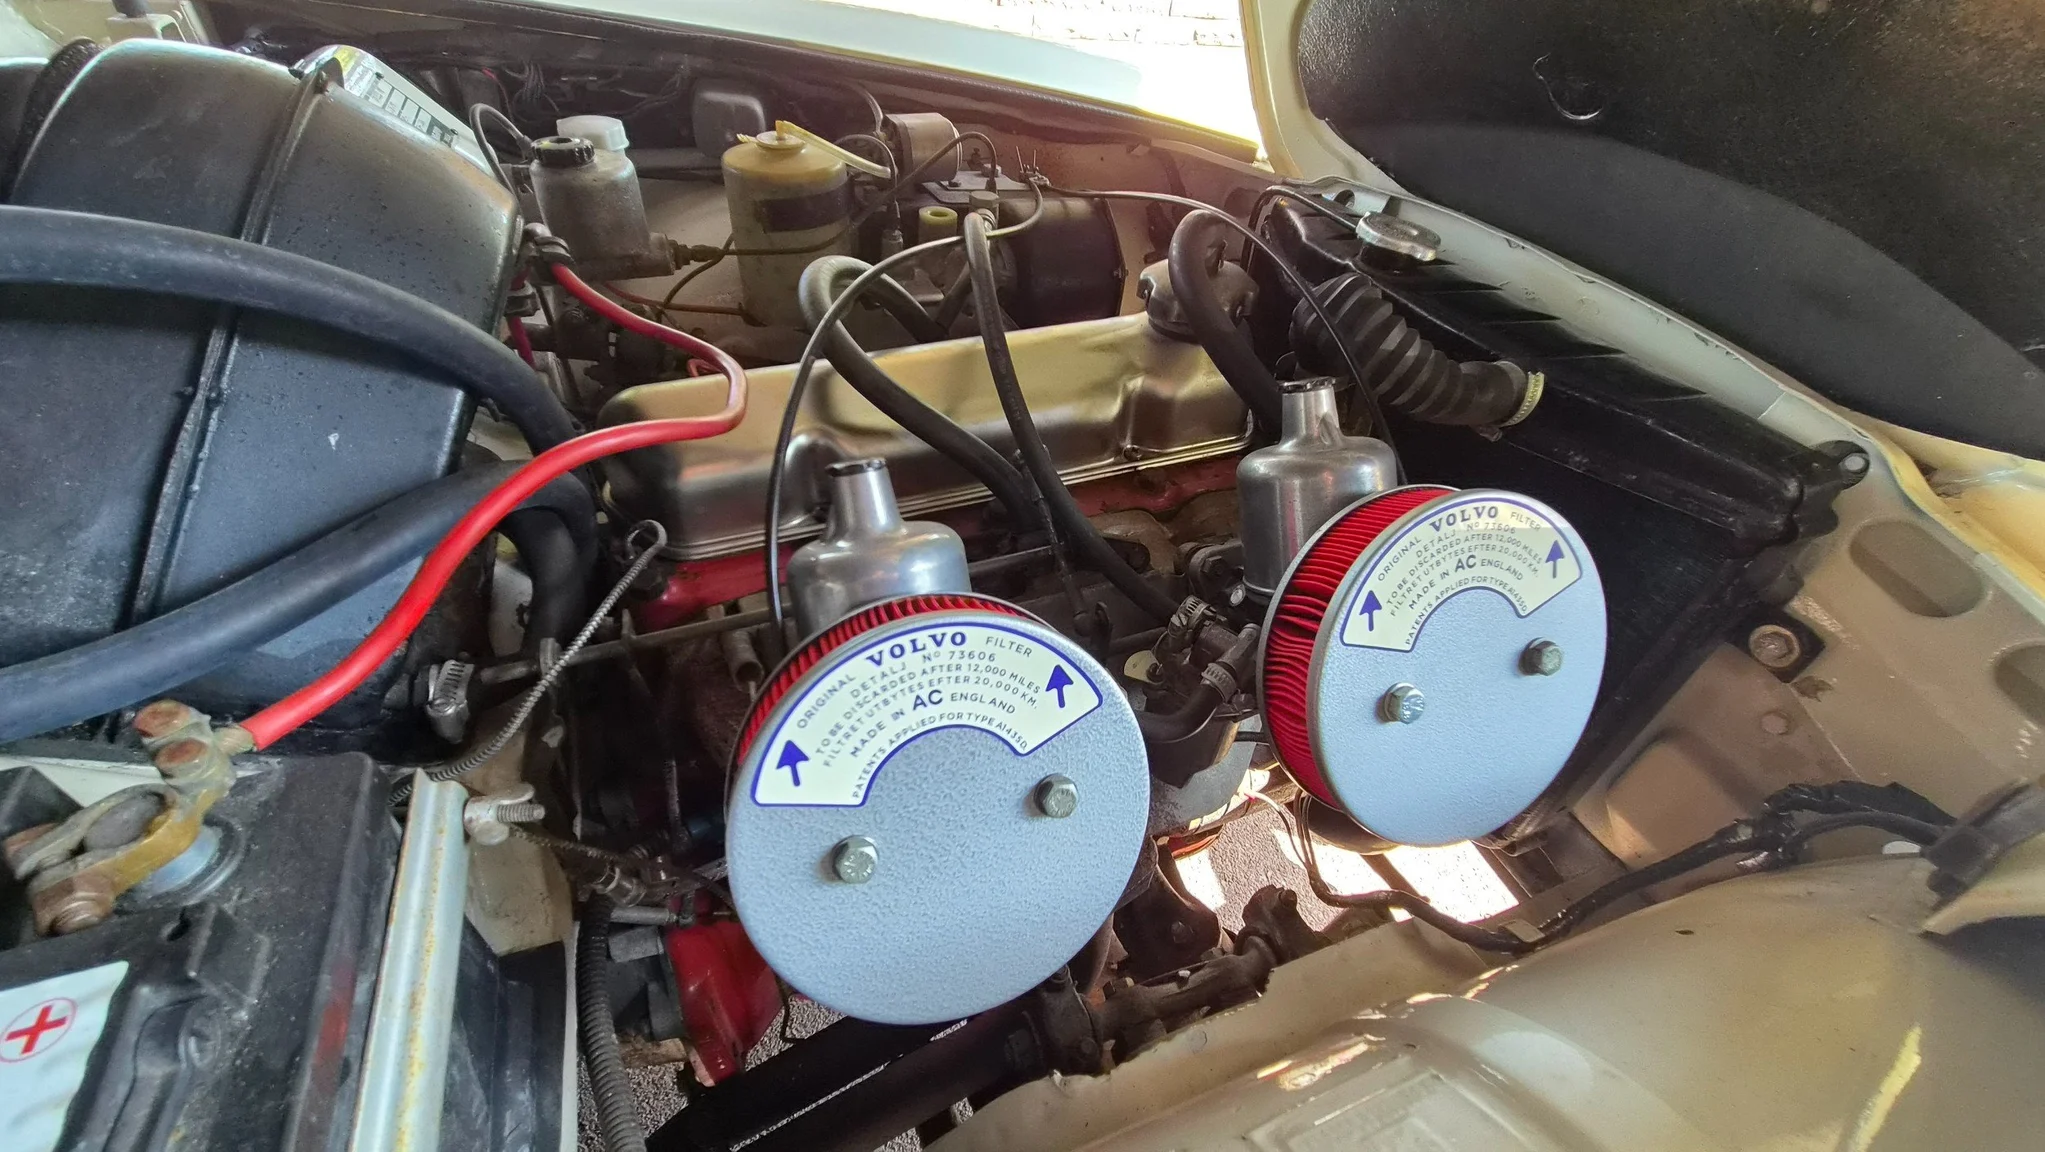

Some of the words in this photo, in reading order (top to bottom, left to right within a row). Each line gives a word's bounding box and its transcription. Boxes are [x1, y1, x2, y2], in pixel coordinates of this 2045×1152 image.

[1378, 536, 1421, 582] ORIGINAL
[1429, 506, 1498, 532] VOLVO
[1510, 512, 1542, 532] FILTER
[1386, 590, 1398, 605] TO
[1396, 578, 1408, 590] BE
[1408, 538, 1461, 577] DISCARDED
[1464, 534, 1492, 543] AFTER
[1416, 529, 1456, 558] DETALJ
[1484, 522, 1516, 534] 73606
[1390, 574, 1422, 616] FILTRET
[1423, 548, 1466, 576] UTBYTES
[1468, 544, 1496, 552] EFTER
[1405, 602, 1432, 645] PATENTS
[1434, 578, 1470, 602] APPLIED
[1490, 576, 1509, 590] TYPE
[1408, 580, 1436, 610] MADE
[1440, 569, 1450, 580] IN
[1454, 554, 1477, 573] AC
[1480, 558, 1523, 580] ENGLAND
[796, 674, 856, 729] ORIGINAL
[865, 631, 968, 668] VOLVO
[985, 636, 1033, 658] FILTER
[816, 738, 831, 755] TO
[828, 722, 844, 737] BE
[843, 672, 917, 720] DISCARDED
[921, 663, 963, 676] AFTER
[967, 663, 1006, 678] 12,000
[1008, 672, 1041, 694] MILES
[850, 662, 907, 699] DETALJ
[948, 651, 996, 662] 73606
[822, 716, 866, 768] FILTRET
[865, 682, 925, 718] UTBYTES
[928, 676, 970, 688] EFTER
[974, 674, 1020, 696] 20,000
[850, 721, 886, 758] MADE
[890, 708, 906, 721] IN
[912, 689, 944, 710] AC
[950, 692, 1016, 714] ENGLAND
[852, 746, 886, 798] PATENTS
[888, 715, 936, 746] APPLIED
[940, 712, 964, 721] FOR
[966, 712, 996, 726] TYPE
